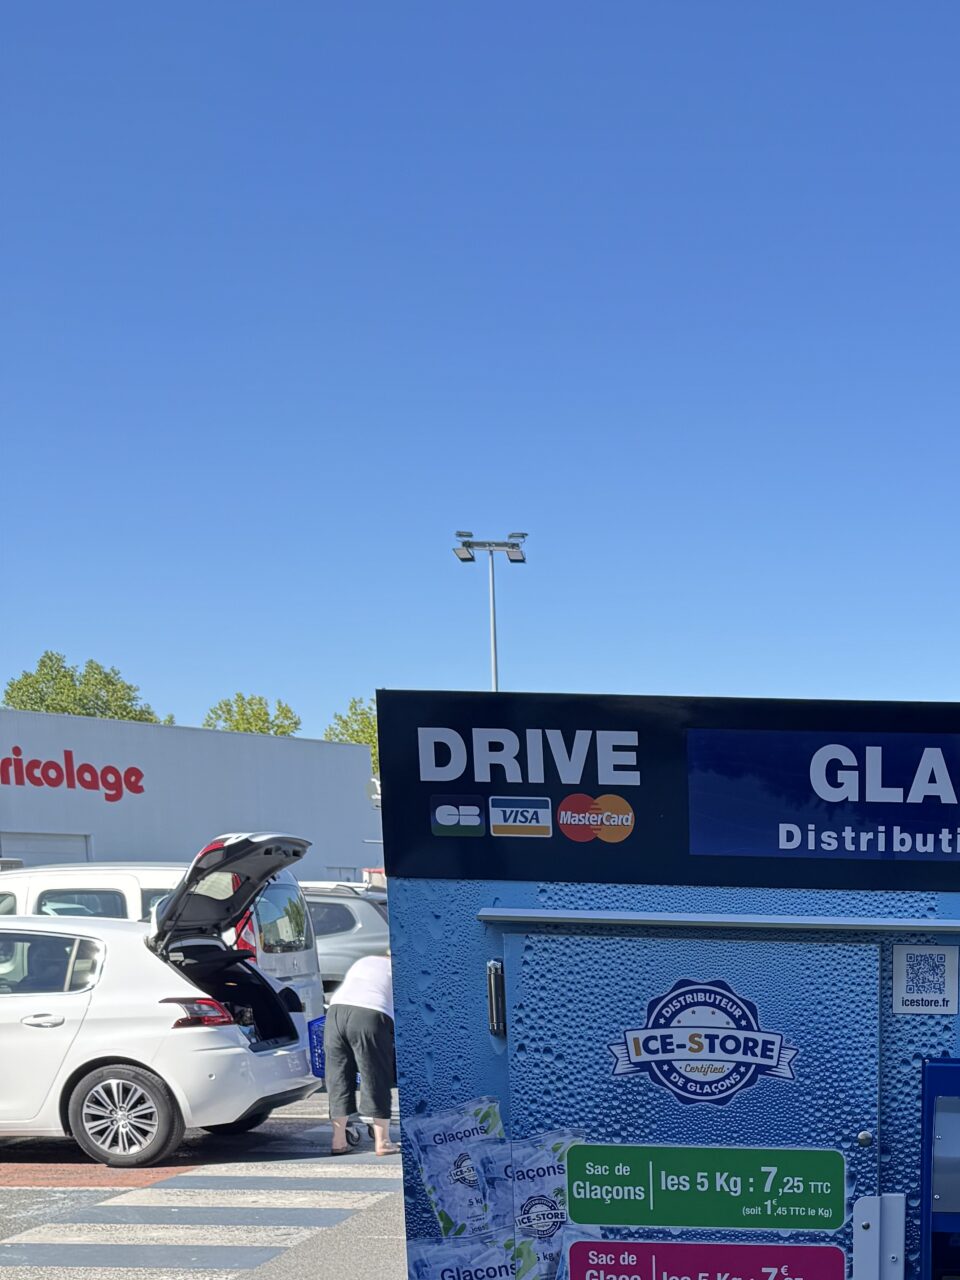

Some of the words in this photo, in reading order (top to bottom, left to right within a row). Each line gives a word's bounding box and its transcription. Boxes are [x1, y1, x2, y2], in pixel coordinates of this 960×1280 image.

[417, 727, 641, 786] DRIVE
[0, 745, 145, 802] ricolage
[499, 809, 541, 825] VISA
[559, 809, 633, 828] MasterCard
[661, 992, 744, 1020] DISTRIBUTEUR
[901, 997, 950, 1008] icestore.fr
[632, 1033, 777, 1060] ICE-STORE
[669, 1072, 685, 1087] DE
[686, 1072, 742, 1095] GLAÇONS
[432, 1124, 488, 1146] Glaçons
[503, 1163, 566, 1182] Gaçons
[585, 1162, 609, 1175] Sac
[615, 1162, 631, 1176] de
[572, 1180, 645, 1204] Glaçons
[661, 1170, 690, 1191] les
[696, 1172, 709, 1192] 5
[715, 1171, 742, 1197] Kg
[808, 1181, 831, 1194] TTC
[517, 1211, 566, 1226] ICE-STORE
[742, 1206, 762, 1216] (soit
[789, 1207, 806, 1216] TTC
[808, 1207, 816, 1216] le
[818, 1207, 833, 1218] Kg)
[588, 1250, 615, 1265] Sac
[619, 1251, 637, 1265] de
